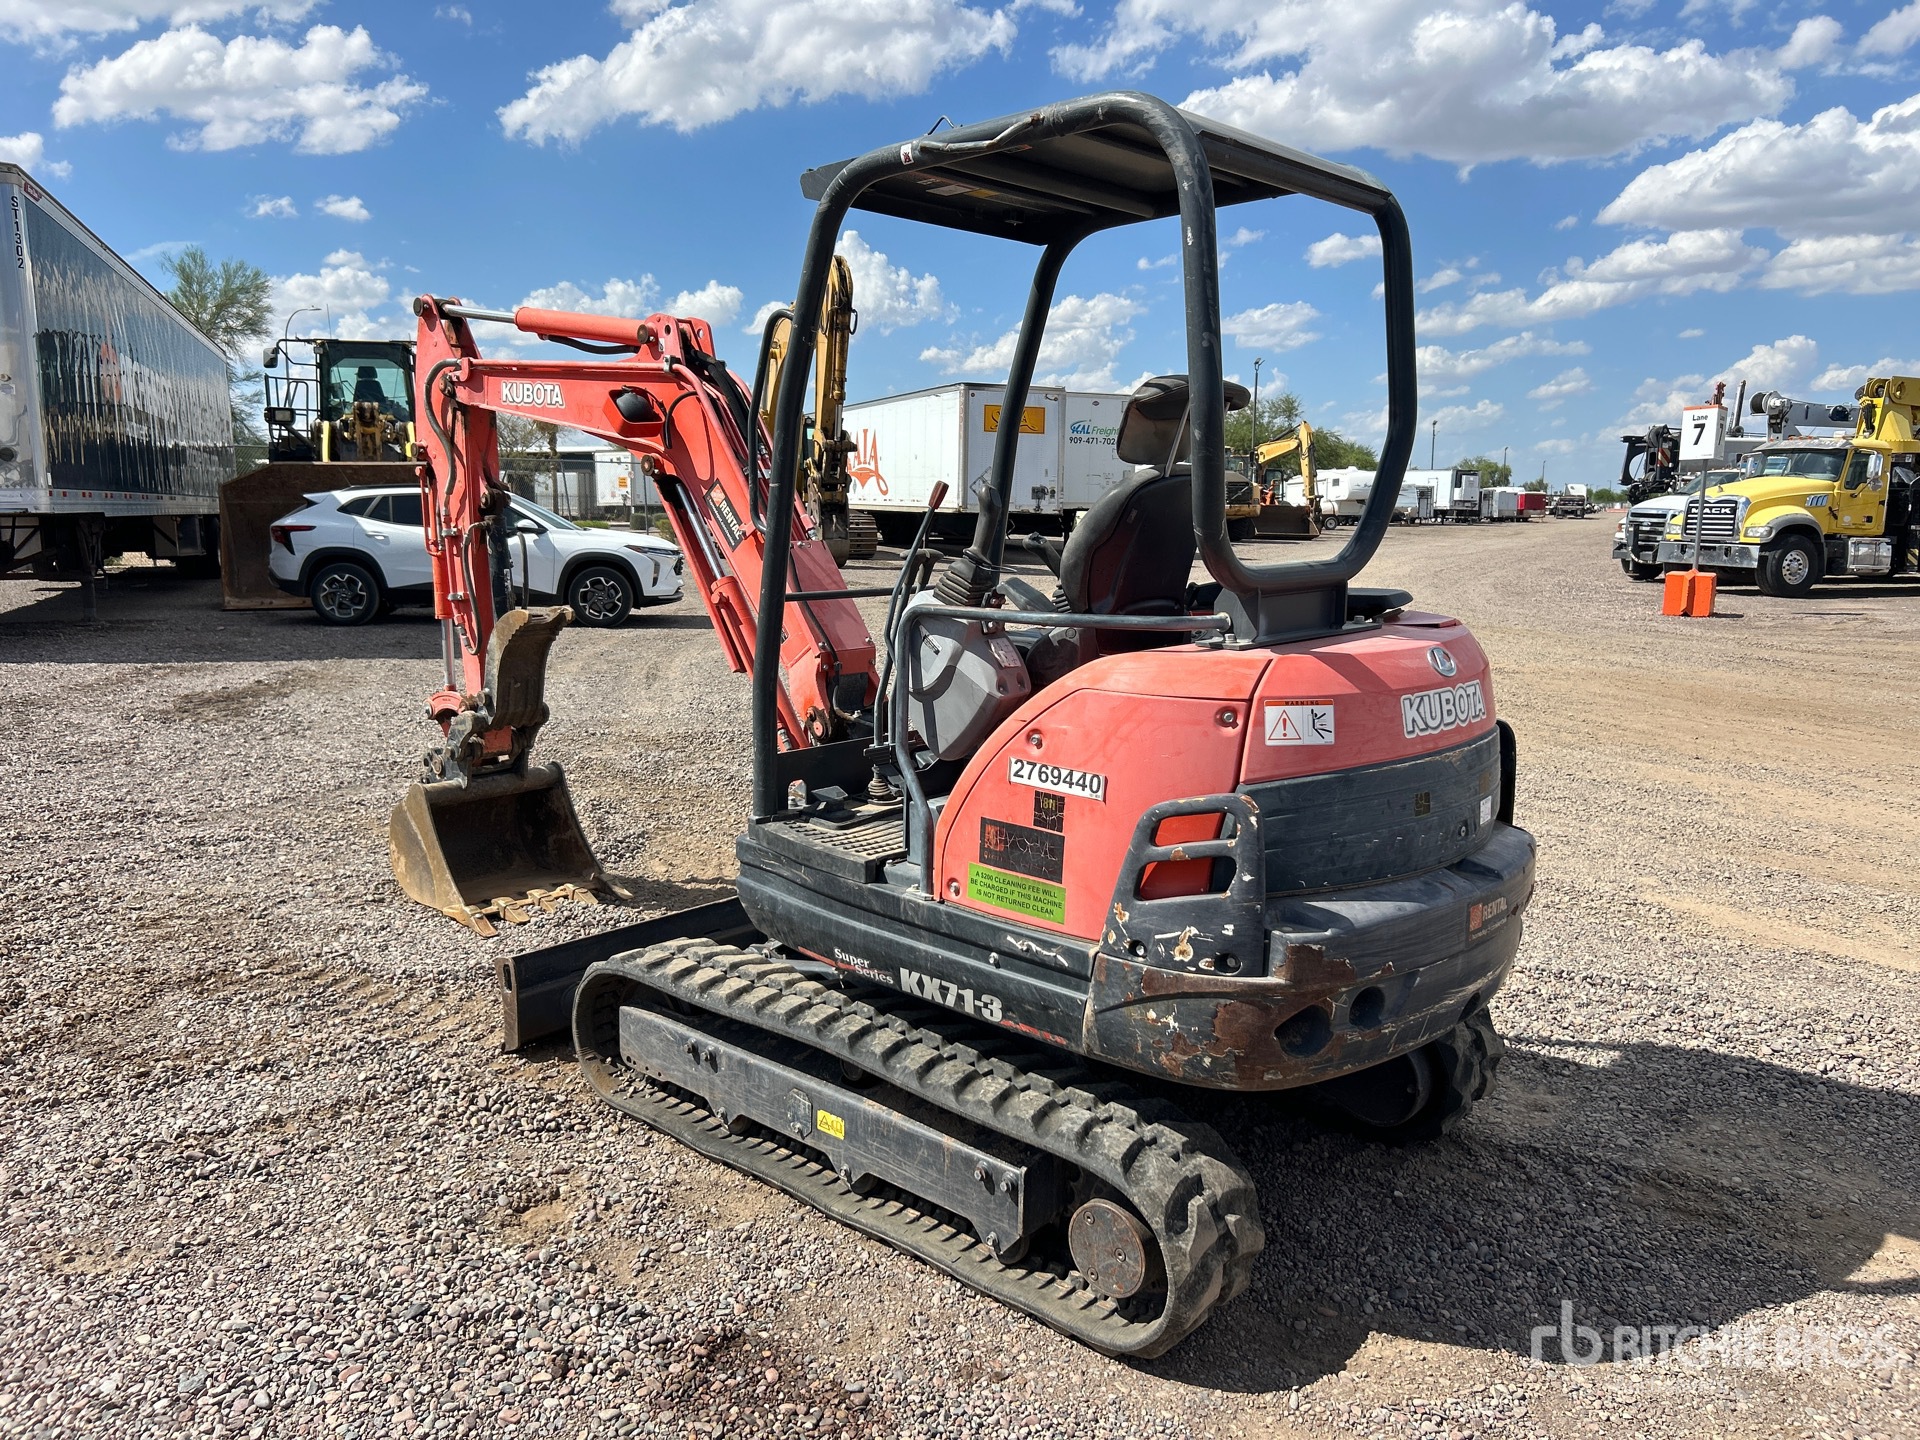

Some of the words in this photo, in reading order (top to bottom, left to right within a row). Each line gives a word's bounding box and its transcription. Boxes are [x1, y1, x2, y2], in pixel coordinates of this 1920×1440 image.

[11, 195, 24, 269] ST1302
[502, 382, 564, 406] KUBOTA
[1069, 436, 1117, 446] 909-471-702
[1693, 423, 1706, 446] 7
[719, 499, 743, 540] RENTAL
[1402, 682, 1486, 735] KUBOTA
[1013, 758, 1101, 794] 2769440
[970, 878, 978, 886] BE
[979, 881, 1008, 894] CHARGED
[1017, 891, 1031, 901] THIS
[1033, 896, 1062, 909] MACHINE
[981, 872, 993, 881] $200
[995, 877, 1027, 890] CLEANING
[1028, 885, 1041, 893] FEE
[1042, 889, 1057, 898] WILL
[983, 891, 995, 899] NOT
[996, 895, 1030, 909] RETURNED
[1032, 904, 1054, 915] CLEAN
[834, 948, 870, 968] Super
[855, 965, 894, 985] Series
[900, 967, 1003, 1023] KX71-3
